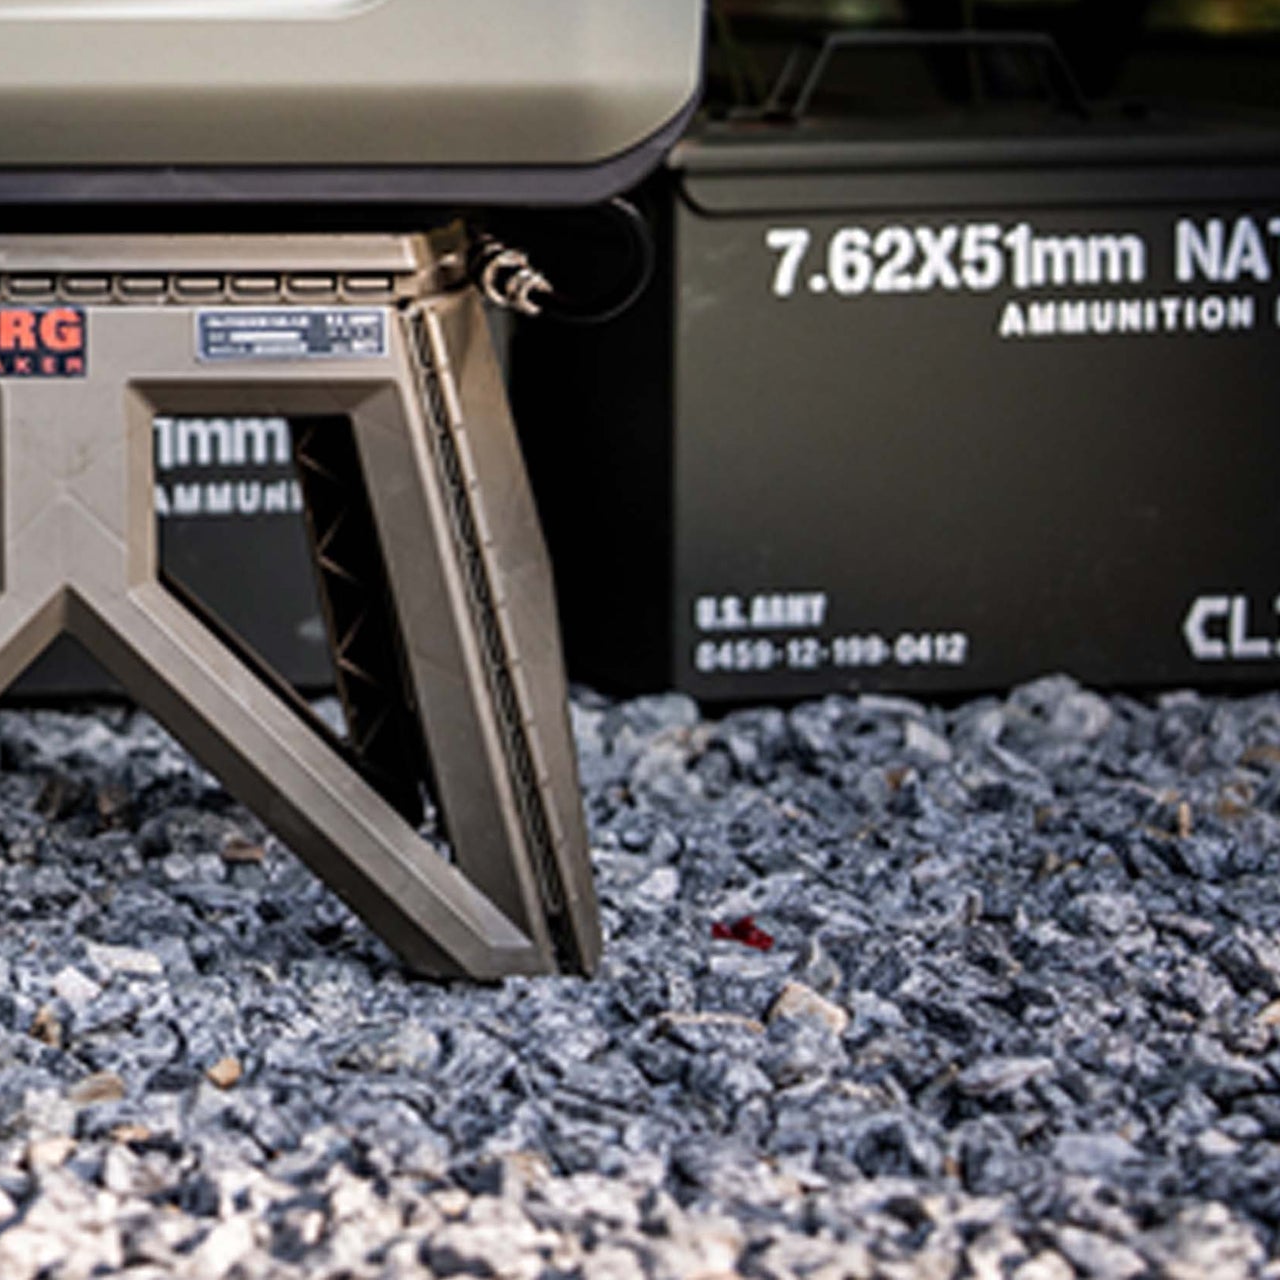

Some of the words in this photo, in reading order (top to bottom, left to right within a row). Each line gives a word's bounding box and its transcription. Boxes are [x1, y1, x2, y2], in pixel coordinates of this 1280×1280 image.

[765, 223, 1145, 296] 7.62X51mm
[999, 297, 1254, 337] AMMUNITION
[1183, 595, 1280, 658] CL
